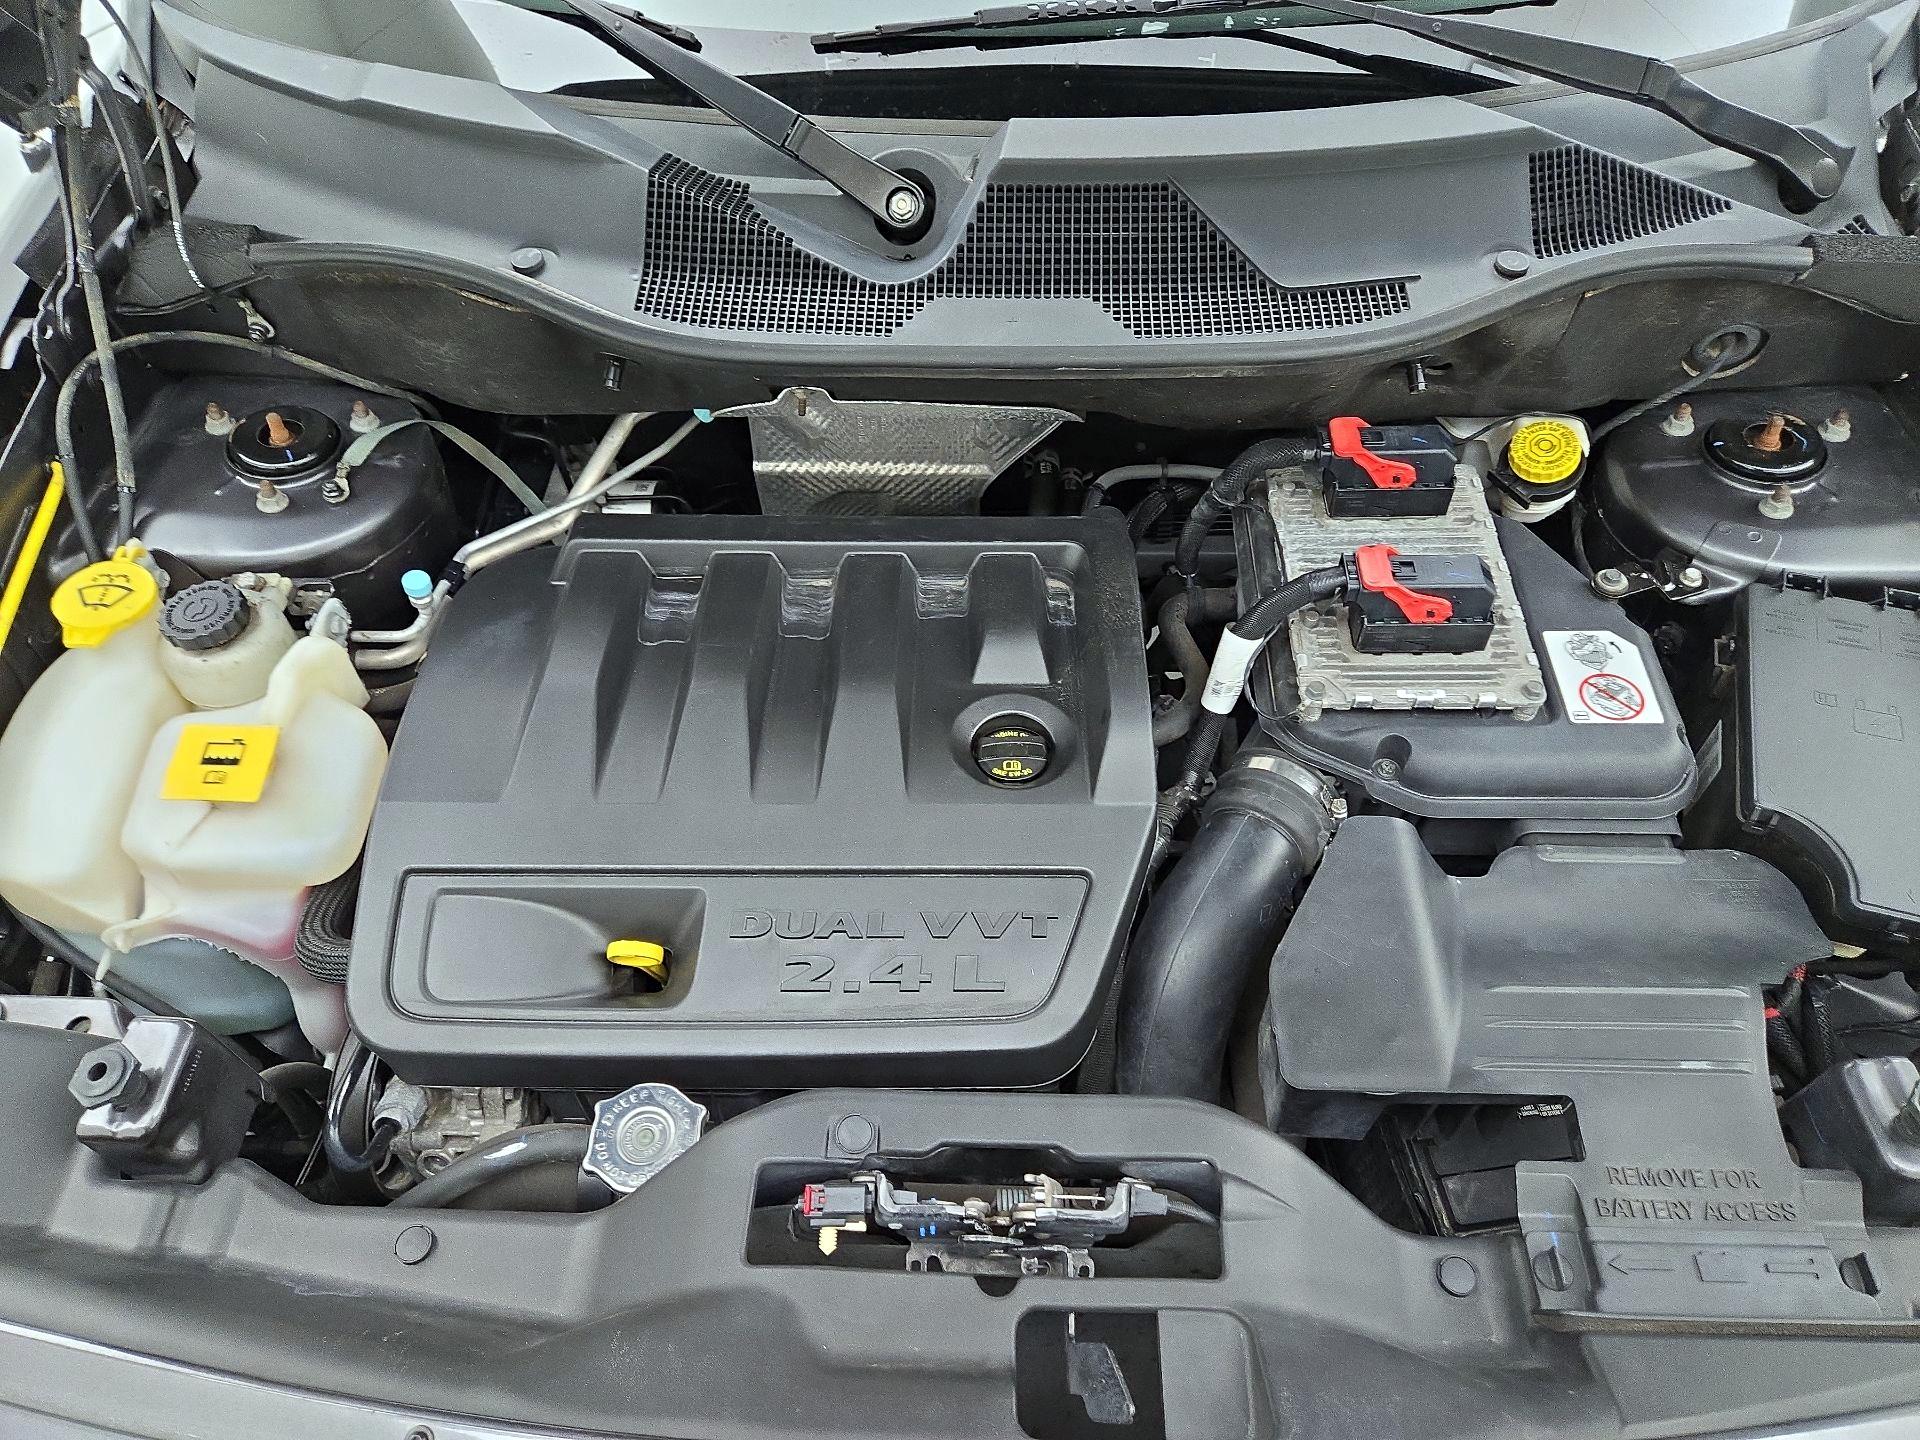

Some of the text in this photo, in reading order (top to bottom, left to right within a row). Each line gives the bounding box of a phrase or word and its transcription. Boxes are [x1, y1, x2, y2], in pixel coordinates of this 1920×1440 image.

[729, 911, 1059, 940] DUAL VVT
[612, 1088, 650, 1114] KEEP
[1605, 1165, 1762, 1190] REMOVE FOR
[1593, 1197, 1798, 1222] BATTERY ACCESS
